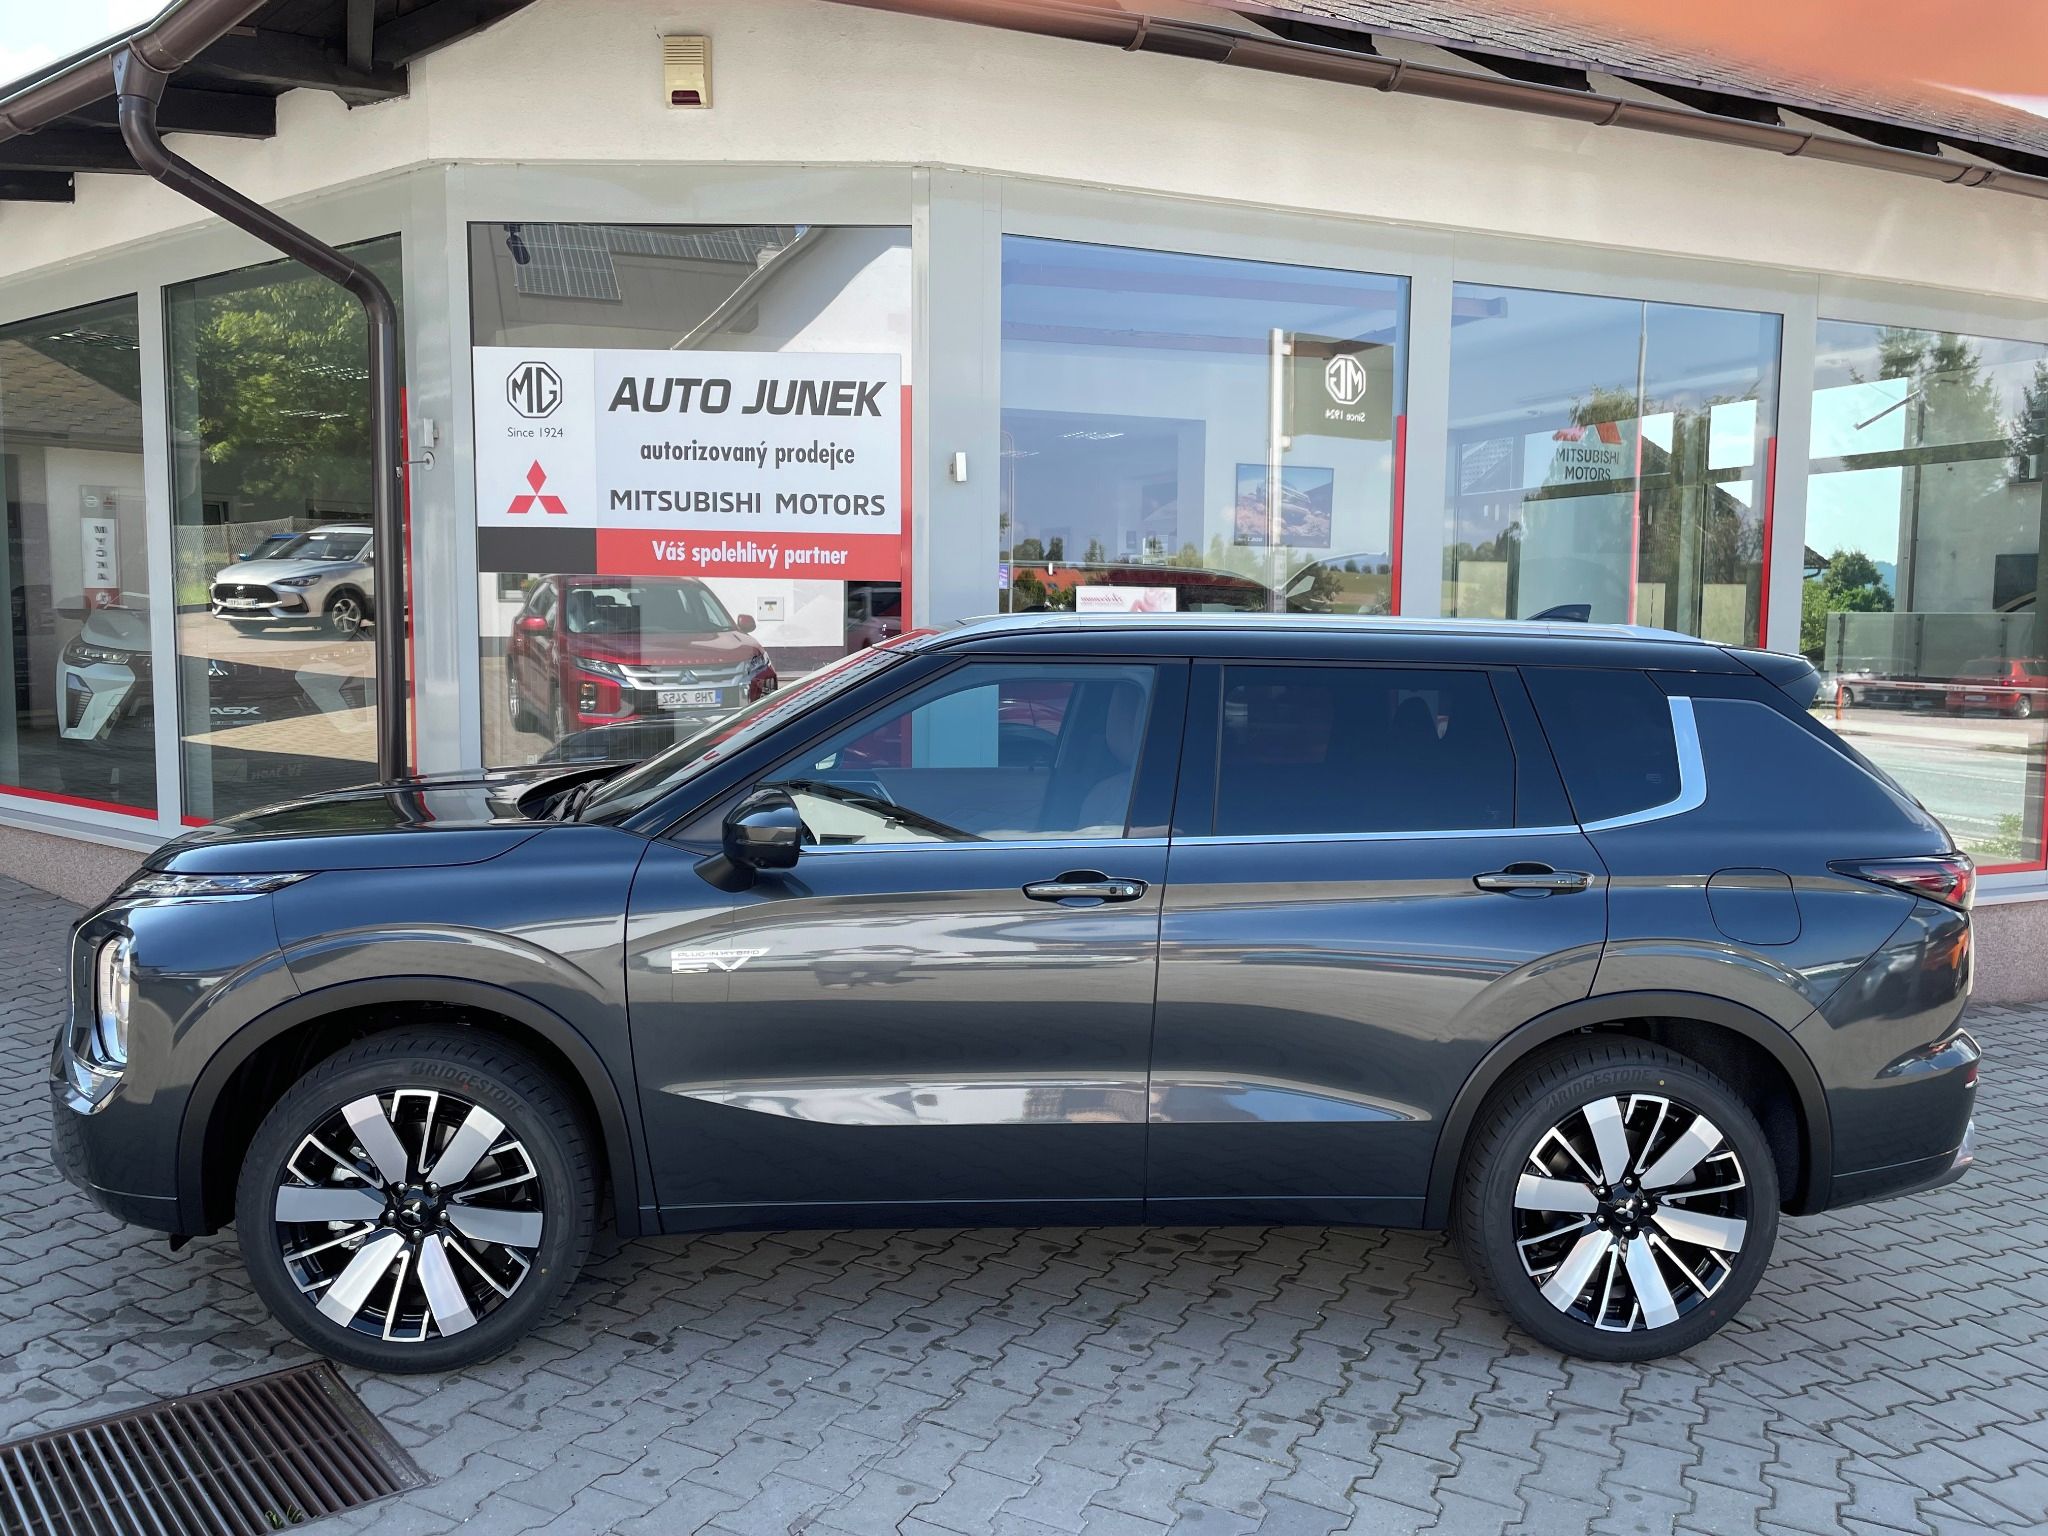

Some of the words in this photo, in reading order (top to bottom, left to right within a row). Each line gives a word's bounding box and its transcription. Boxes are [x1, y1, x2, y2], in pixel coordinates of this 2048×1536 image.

[511, 366, 558, 413] MG
[608, 377, 732, 414] AUTO
[741, 379, 888, 417] JUNEK
[507, 426, 534, 438] Since
[539, 427, 564, 438] 1924
[640, 439, 768, 469] autorizovaný
[775, 439, 855, 470] prodejce
[1555, 448, 1620, 465] MITSUBISHI
[1564, 466, 1611, 481] MOTORS
[610, 489, 761, 513] MITSUBISHI
[775, 492, 886, 516] MOTORS
[651, 540, 686, 561] Váš
[691, 540, 779, 569] spolehlivý
[784, 545, 848, 570] partner
[410, 1062, 526, 1115] BRIDGESTONE
[1546, 1068, 1651, 1110] BRIDGESTONE
